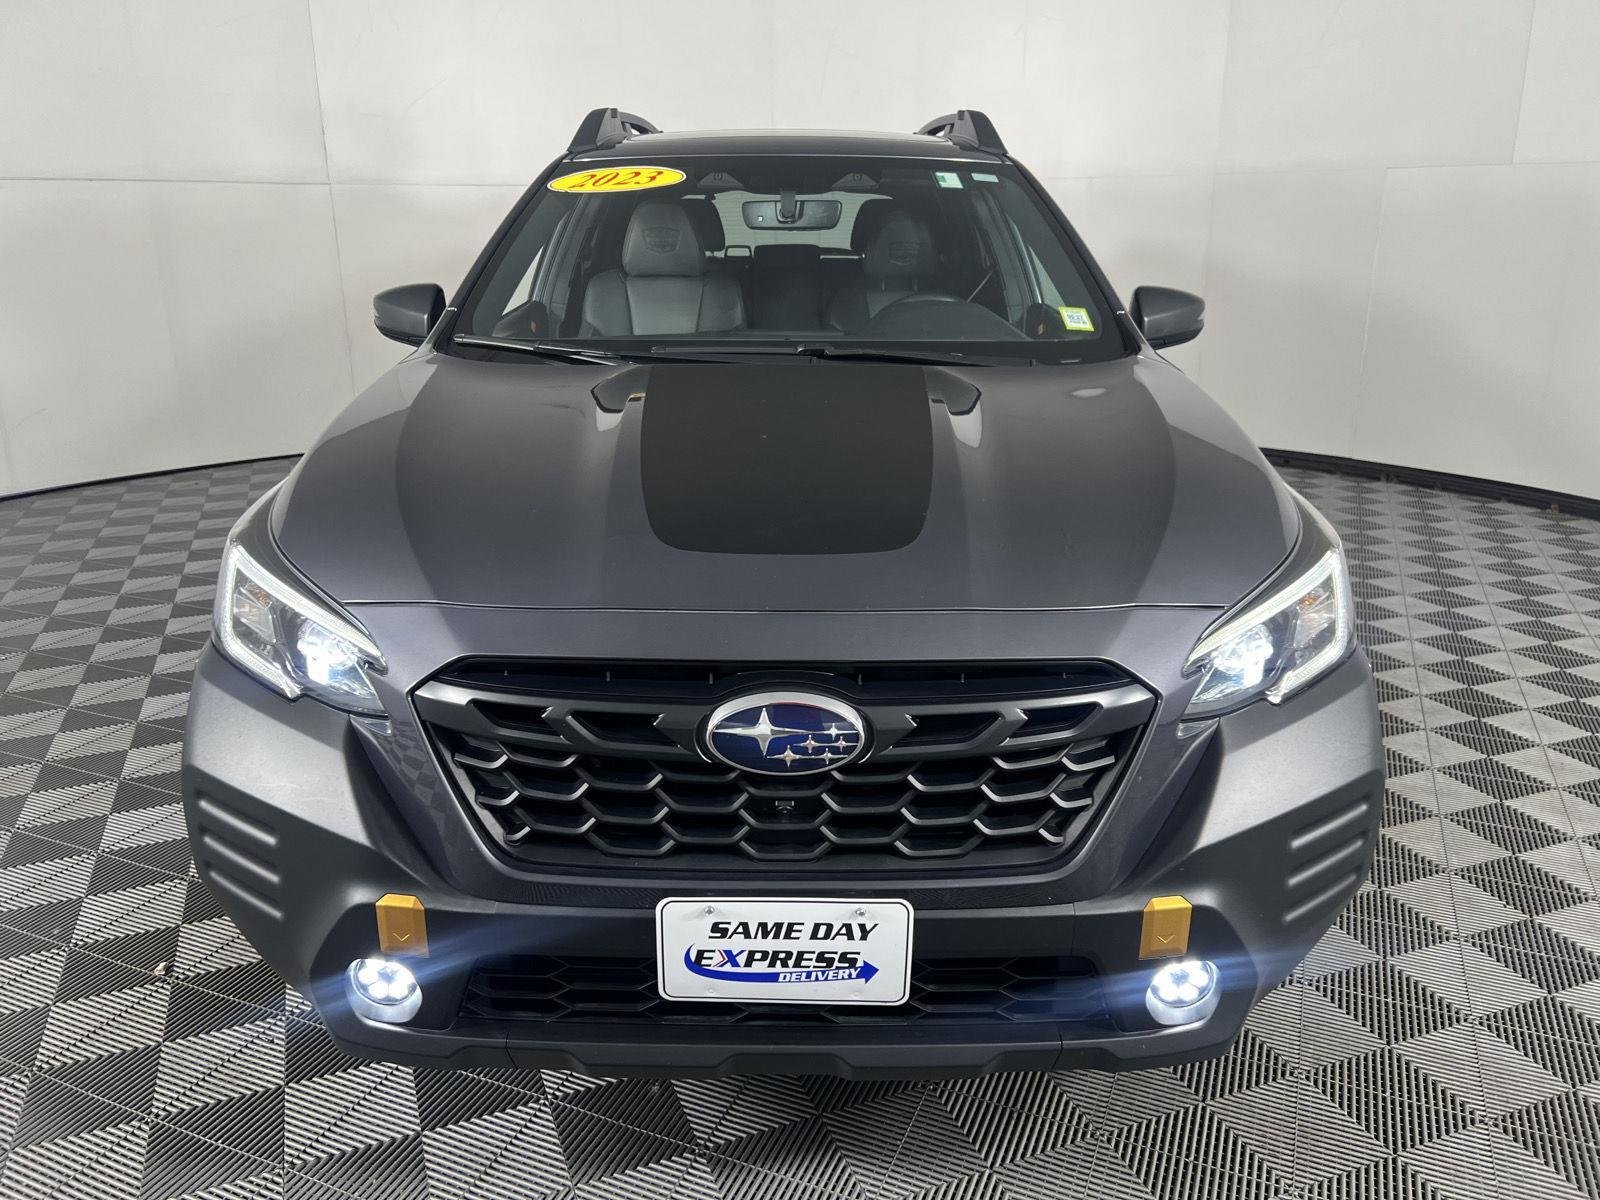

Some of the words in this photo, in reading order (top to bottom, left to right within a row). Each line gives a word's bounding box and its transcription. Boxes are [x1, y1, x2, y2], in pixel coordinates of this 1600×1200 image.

[568, 171, 664, 189] 2023
[708, 921, 804, 940] SAME
[809, 922, 879, 941] DAY
[694, 949, 861, 969] EXPRESS
[778, 967, 862, 983] DELIVERY
